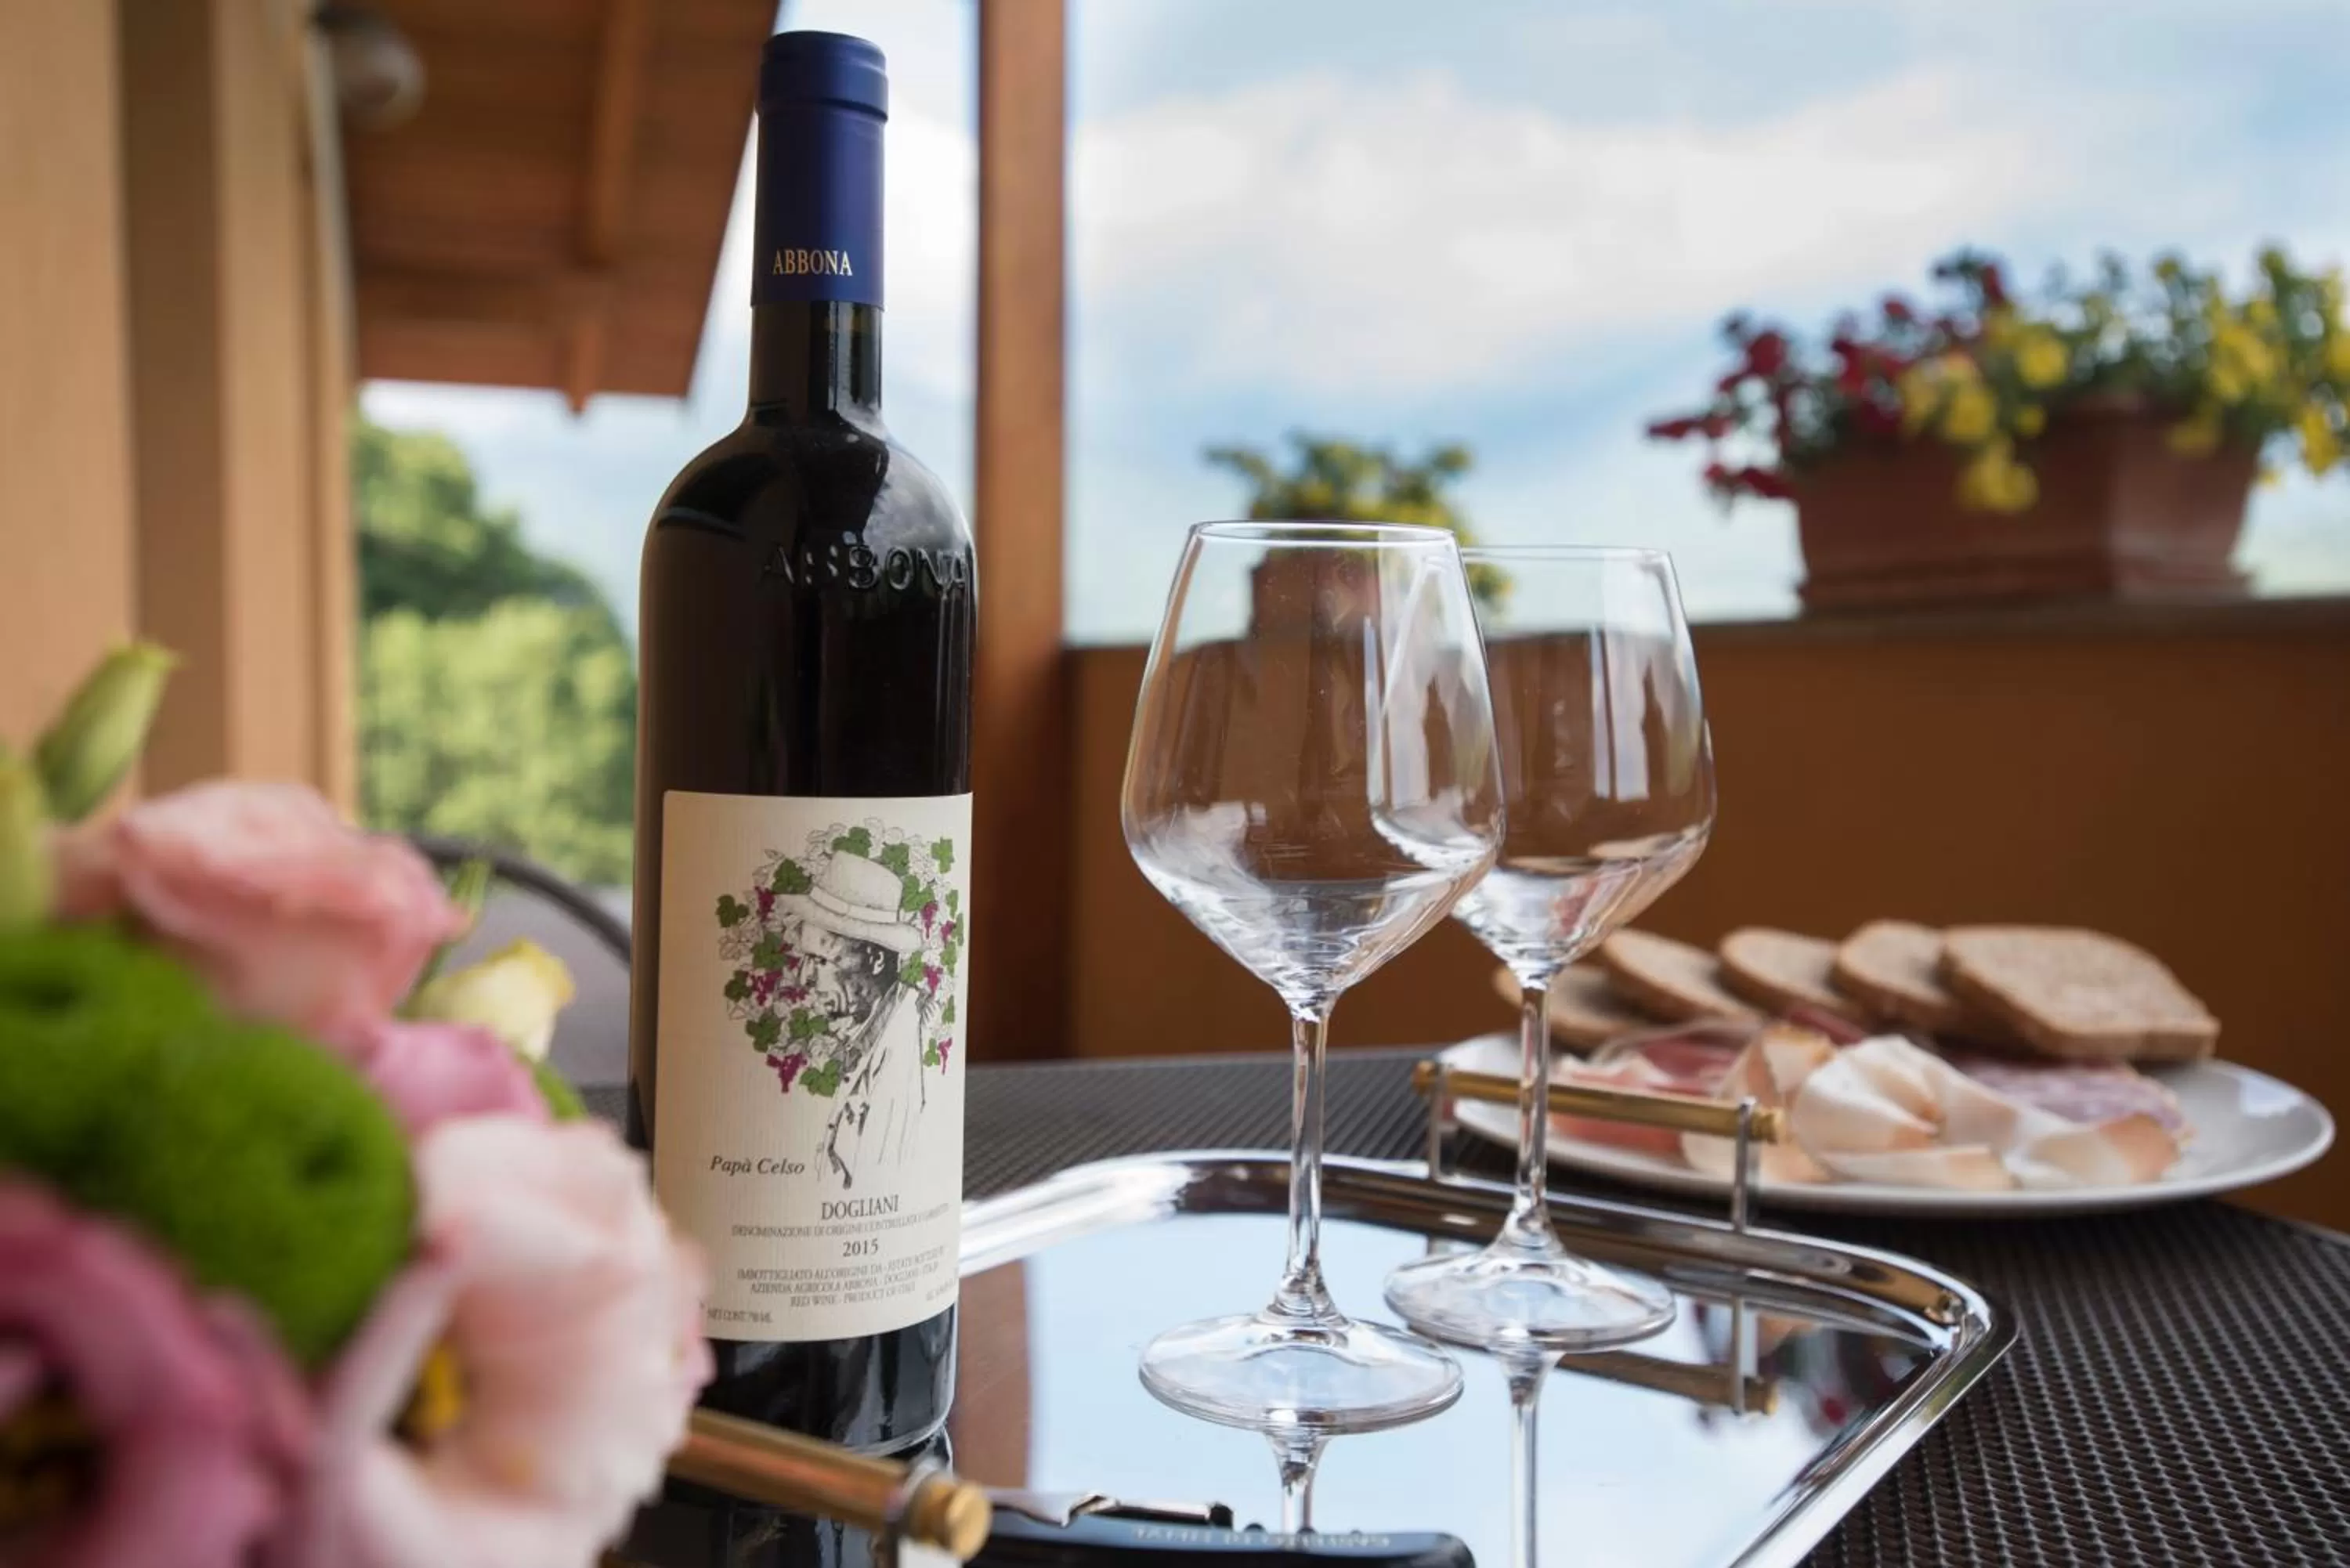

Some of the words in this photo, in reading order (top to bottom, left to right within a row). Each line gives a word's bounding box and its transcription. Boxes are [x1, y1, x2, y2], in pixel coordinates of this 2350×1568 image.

[772, 249, 853, 276] ABBONA
[710, 1155, 751, 1176] Papà
[757, 1158, 805, 1175] Celso
[821, 1194, 899, 1220] DOGLIANI
[843, 1238, 878, 1257] 2015
